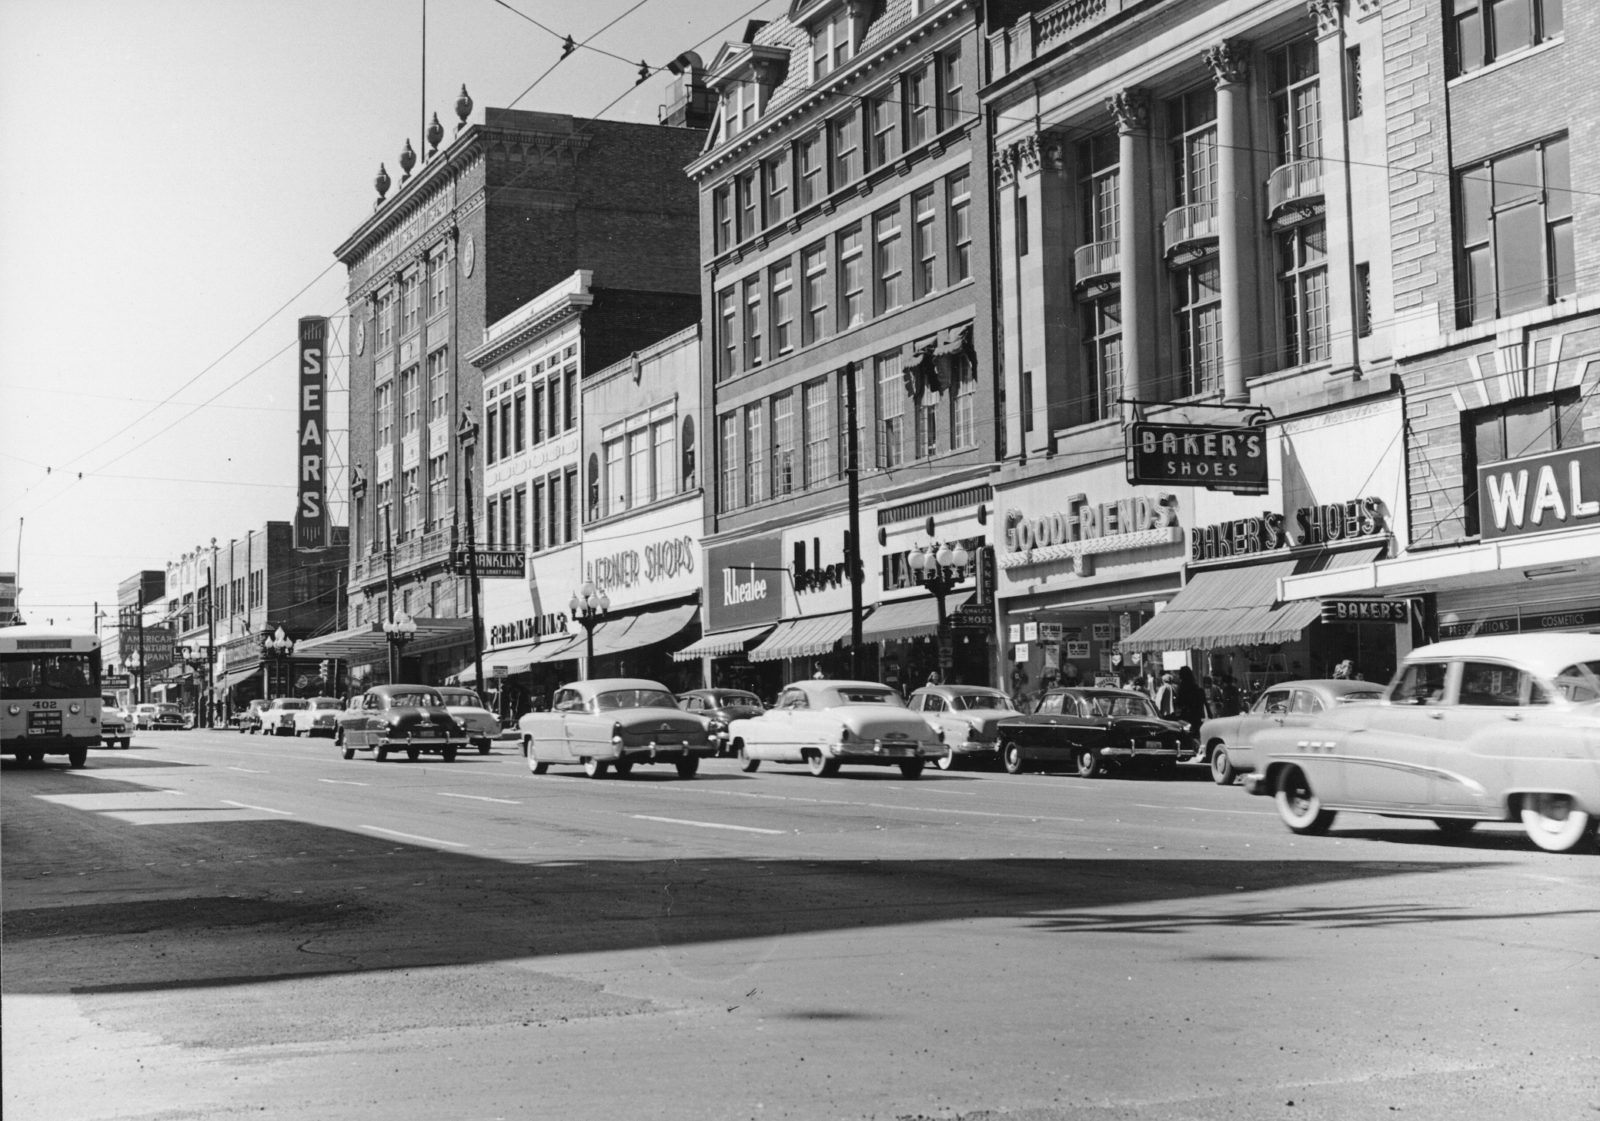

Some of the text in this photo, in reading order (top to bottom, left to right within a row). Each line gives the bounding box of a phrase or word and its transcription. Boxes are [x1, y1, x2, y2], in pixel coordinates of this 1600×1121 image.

[301, 349, 321, 518] SEARS
[1142, 431, 1261, 458] BAKER'S
[1167, 461, 1238, 477] SHOES
[1486, 460, 1600, 532] WAL
[1192, 496, 1382, 561] BAKER'S SHOES
[644, 535, 694, 582] SHOPS
[962, 615, 993, 624] SHOES
[1337, 602, 1404, 618] BAKER'S
[1541, 613, 1585, 627] COSMETICS
[32, 701, 57, 709] 402
